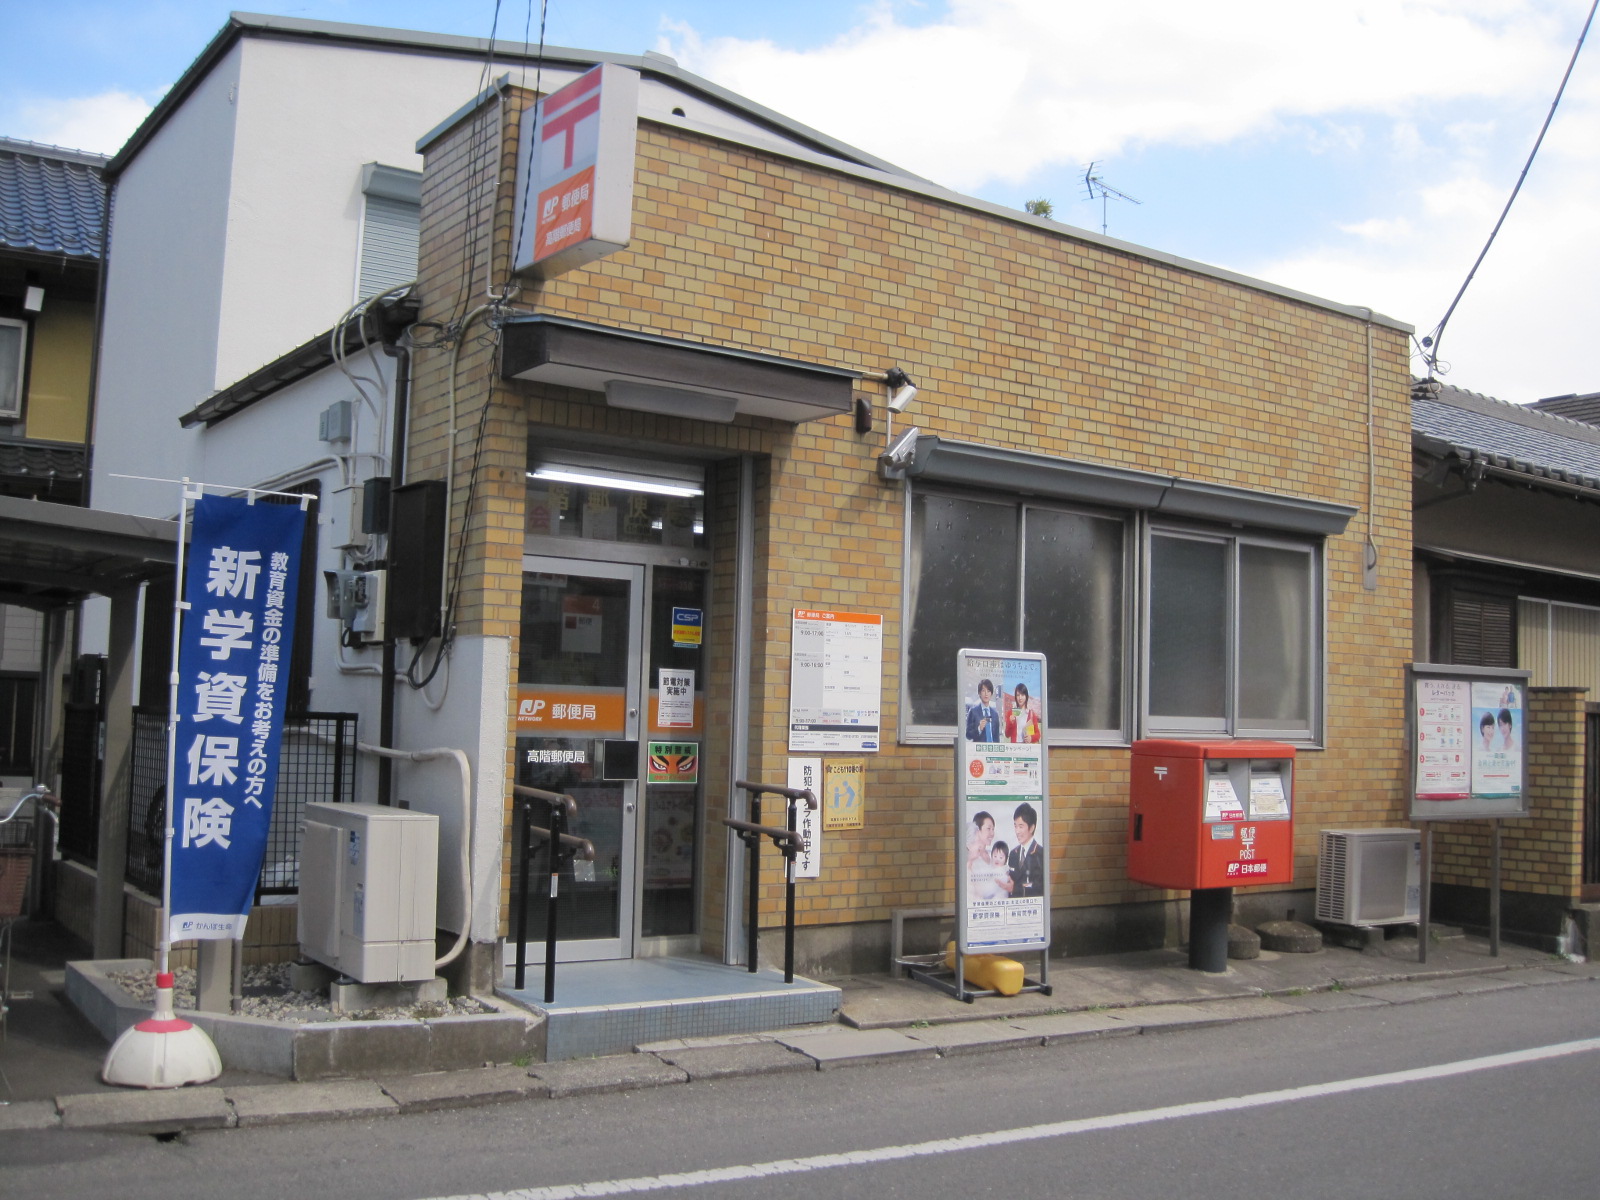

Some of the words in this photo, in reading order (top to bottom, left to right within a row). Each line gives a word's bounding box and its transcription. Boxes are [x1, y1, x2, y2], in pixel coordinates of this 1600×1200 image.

[562, 183, 589, 212] 郵便局
[676, 613, 699, 621] CSP
[244, 552, 289, 809] 教育資金の準備をお考えの方へ
[182, 546, 262, 849] 新学資保険
[667, 686, 687, 696] 実施中
[552, 703, 596, 720] 郵便局
[527, 749, 585, 764] 高階郵便局
[1240, 849, 1255, 860] POST
[1241, 863, 1267, 874] 日本郵便
[196, 922, 233, 930] かんぽ生命
